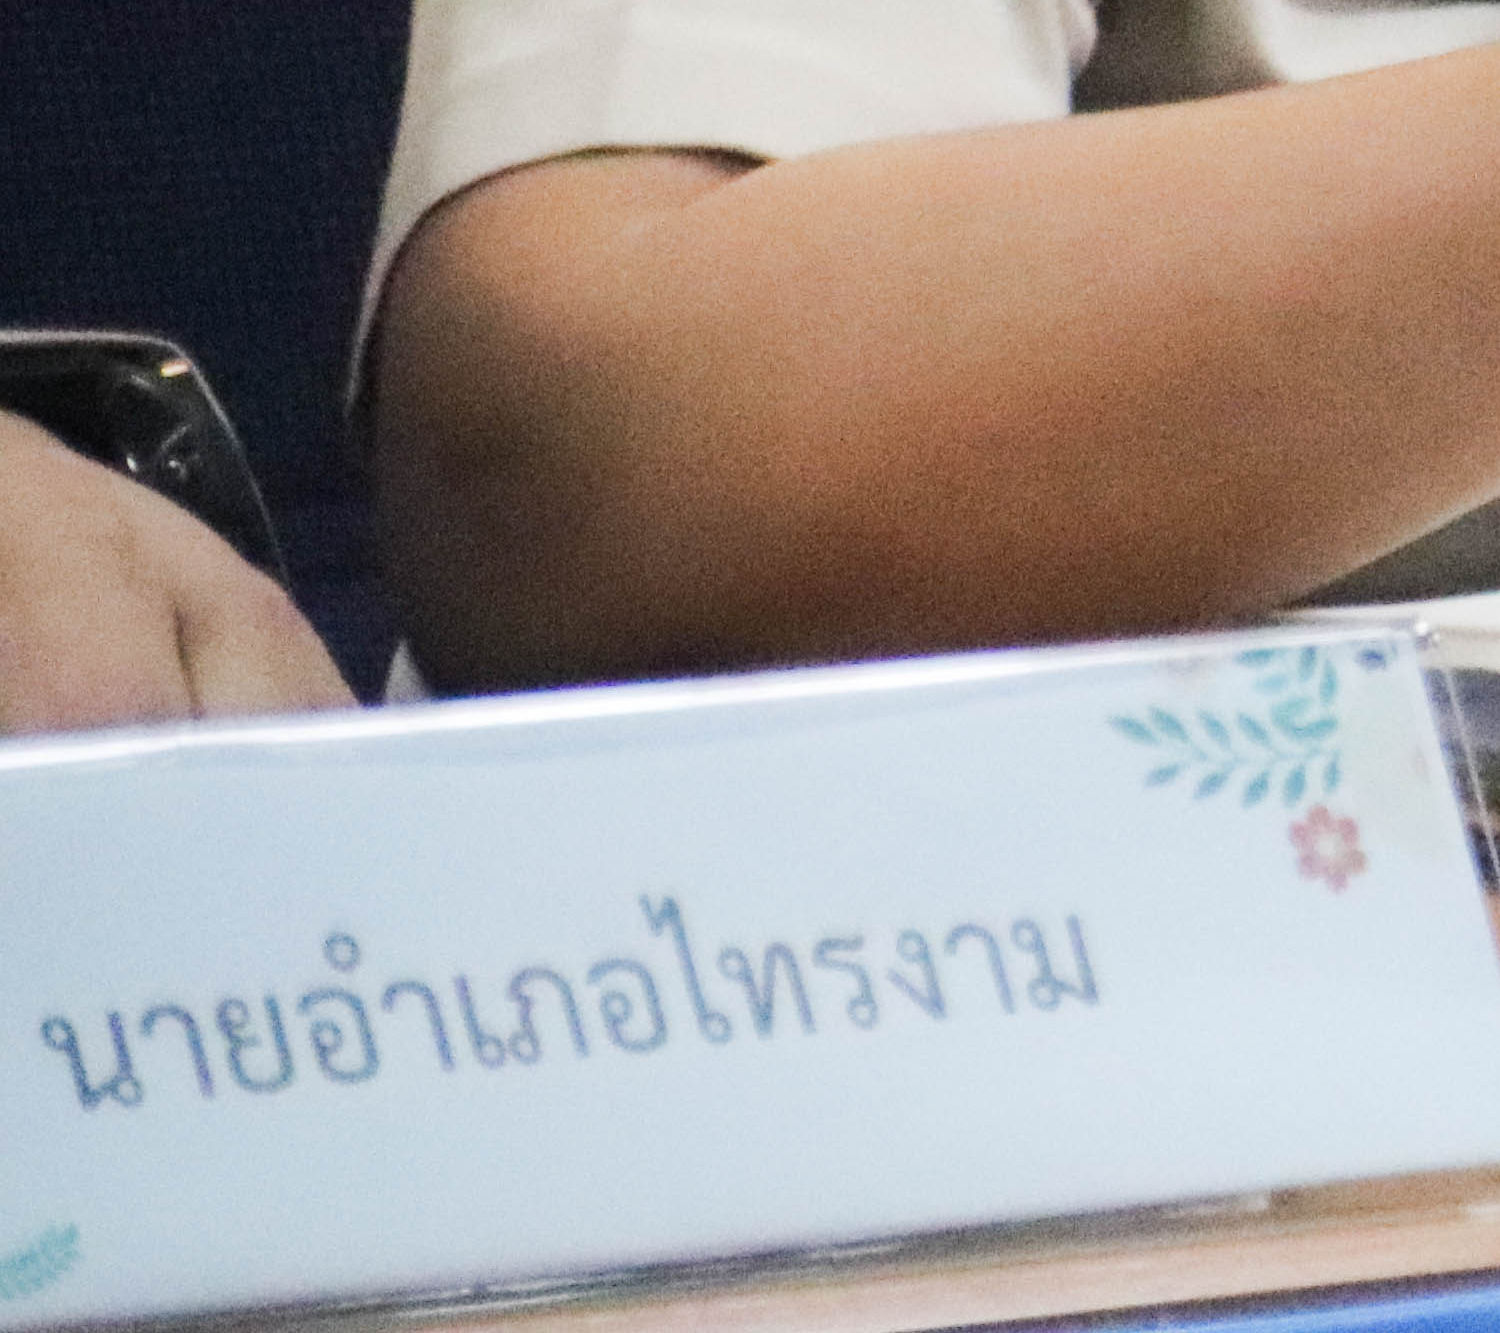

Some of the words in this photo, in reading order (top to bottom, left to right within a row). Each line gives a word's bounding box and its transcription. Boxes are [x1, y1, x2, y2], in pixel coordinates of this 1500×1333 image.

[39, 891, 1101, 1111] นายอำเภอไทรงาม
